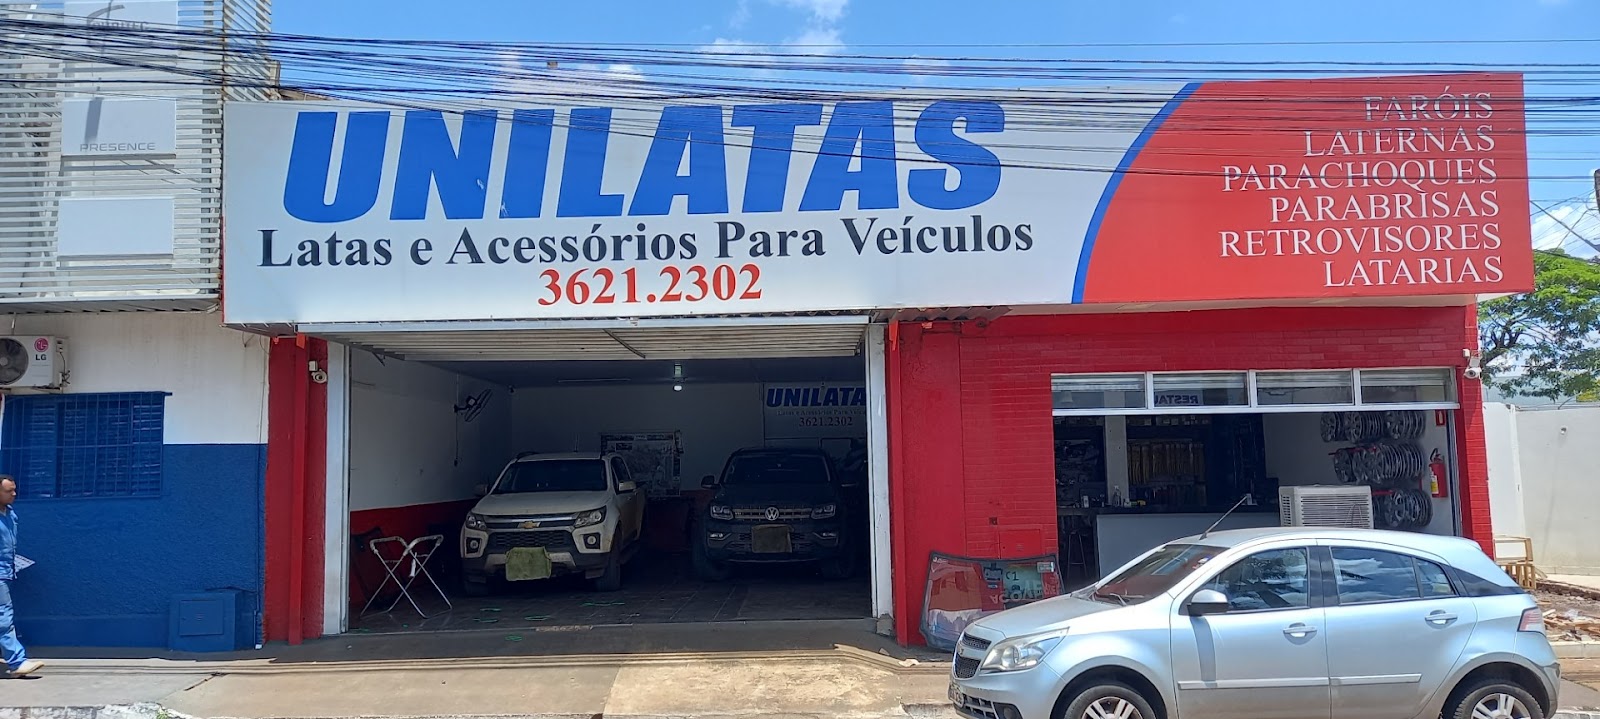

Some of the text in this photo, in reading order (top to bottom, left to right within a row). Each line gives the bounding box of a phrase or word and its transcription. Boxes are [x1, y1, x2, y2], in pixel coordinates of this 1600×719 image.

[1362, 86, 1493, 121] FARÓIS
[80, 142, 156, 152] PRESENCE
[1303, 124, 1495, 157] LATERNAS
[283, 99, 1005, 223] UNILATAS
[1222, 158, 1497, 192] PARACHOQUES
[1269, 190, 1500, 223] PARABRISAS
[257, 214, 1033, 267] Latas e Acessórios Para Veículos
[1220, 222, 1501, 258] RETROVISORES
[538, 263, 762, 306] 3621.2302
[1324, 256, 1504, 287] LATARIAS
[799, 416, 853, 427] 3621.2302
